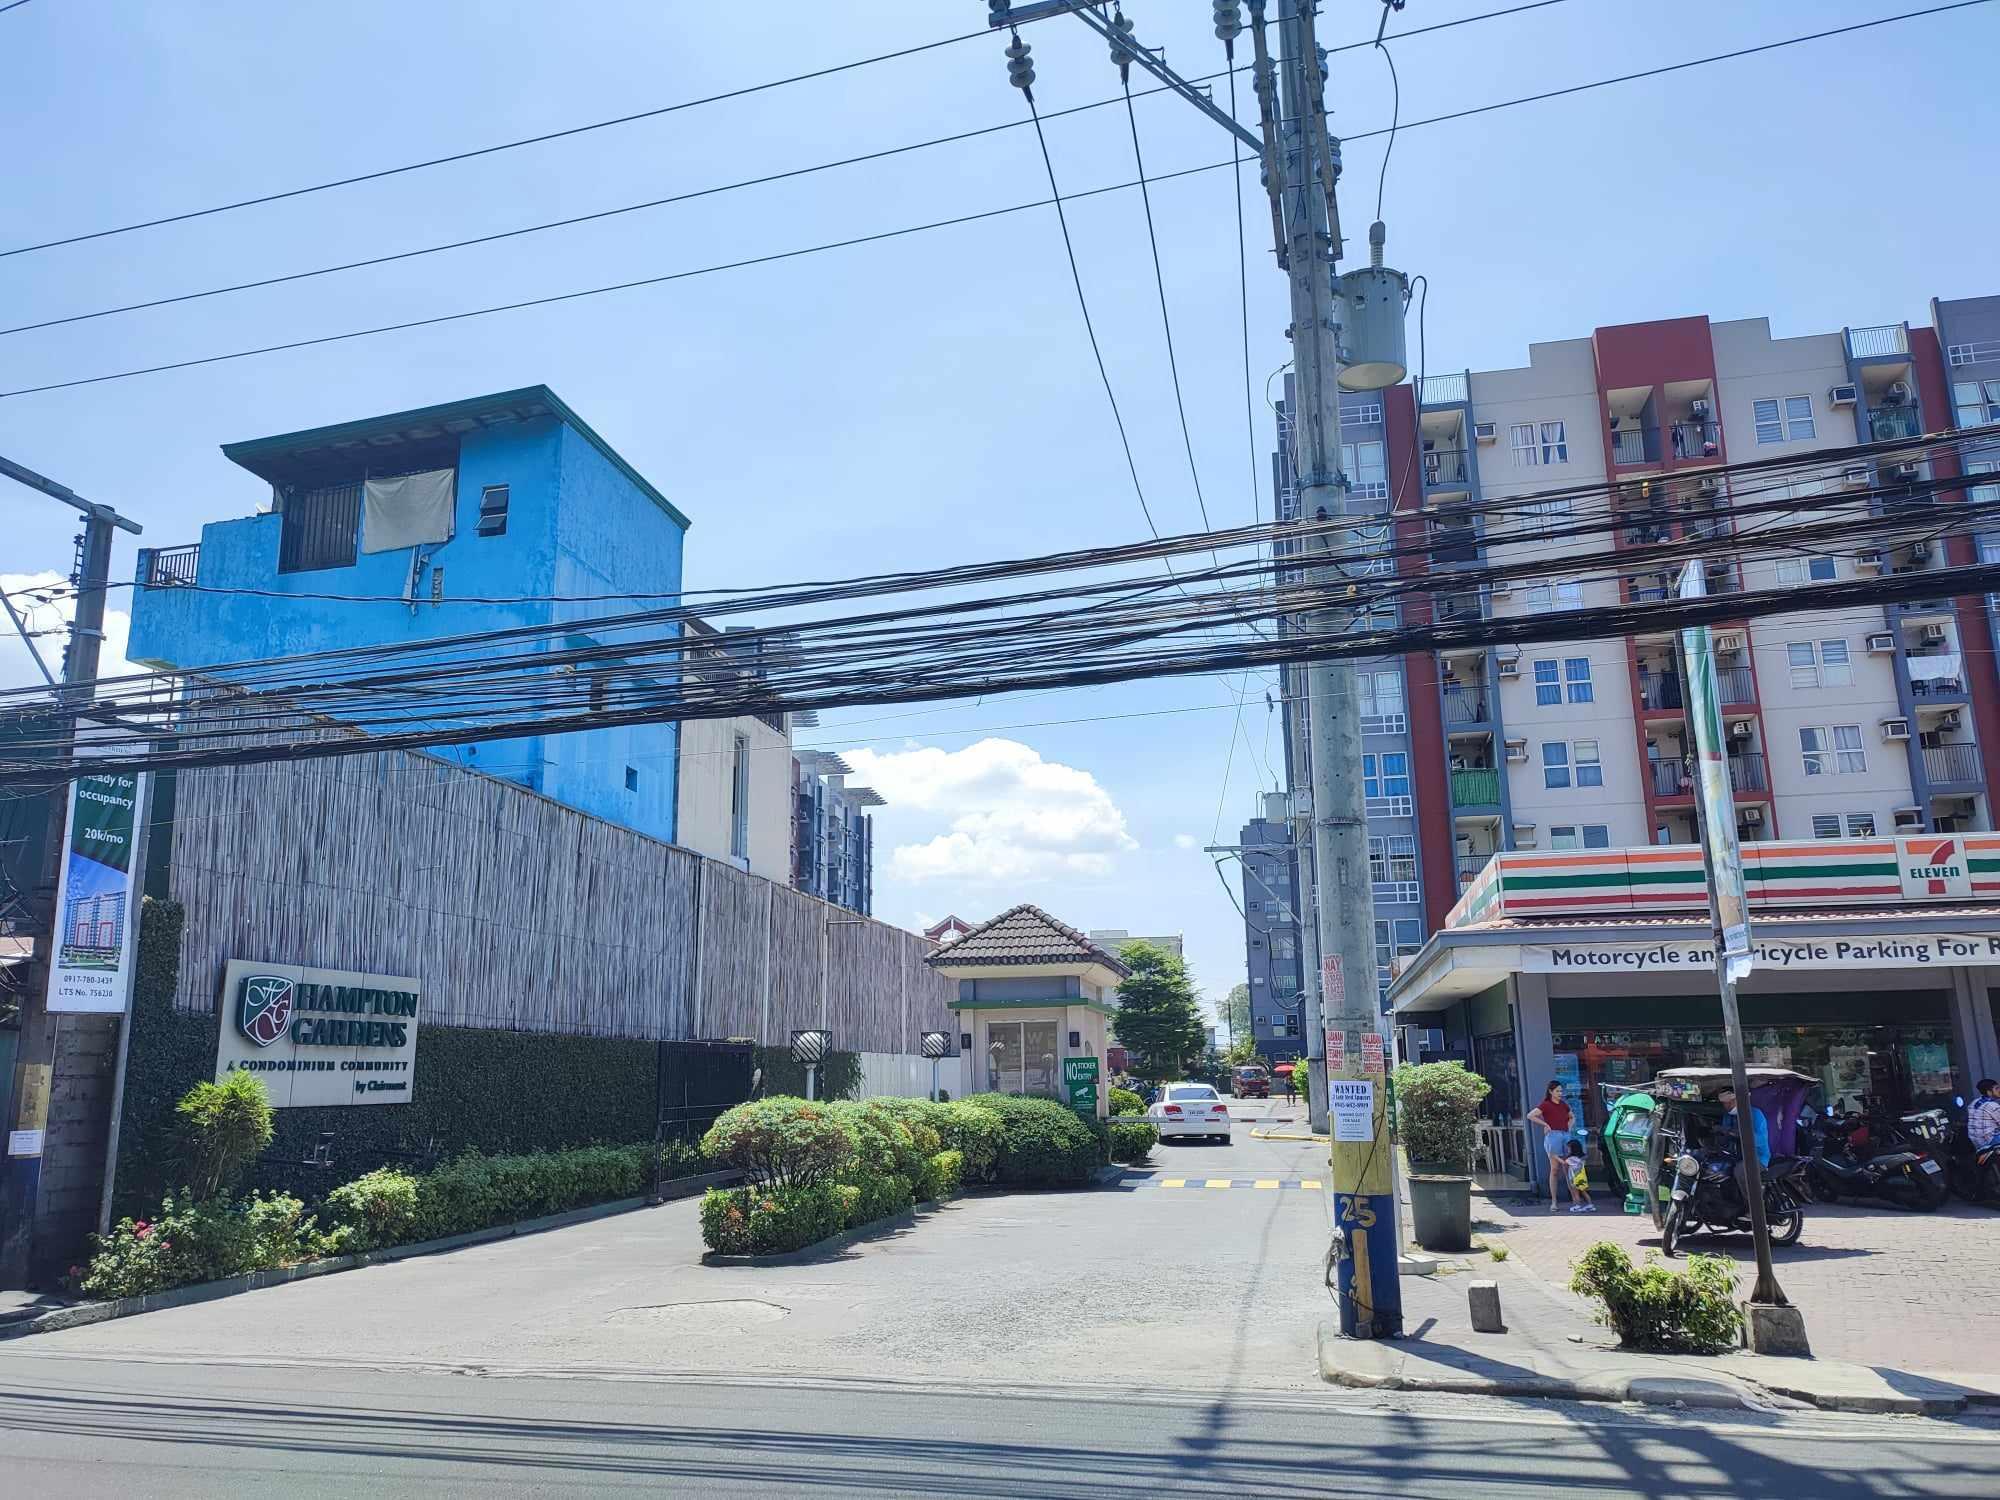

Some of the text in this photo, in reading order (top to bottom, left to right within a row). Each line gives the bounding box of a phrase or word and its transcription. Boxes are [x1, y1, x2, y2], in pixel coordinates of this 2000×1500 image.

[118, 776, 133, 788] for
[79, 790, 134, 810] occupancy
[84, 827, 124, 844] 20k/mo
[1551, 946, 1680, 969] Motorcycle
[1687, 950, 1715, 963] an
[1752, 943, 1829, 966] ricycle
[1835, 940, 1931, 962] Parking
[1936, 938, 1980, 957] For
[294, 983, 420, 1018] HAMPTON
[291, 1017, 408, 1048] GARDENS
[239, 1060, 336, 1072] CONDOMINIUM
[340, 1060, 409, 1072] COMMUNITY
[1066, 1062, 1078, 1080] NO
[355, 1080, 367, 1094] by
[1334, 1084, 1368, 1095] WANTED
[1340, 1197, 1376, 1228] 25
